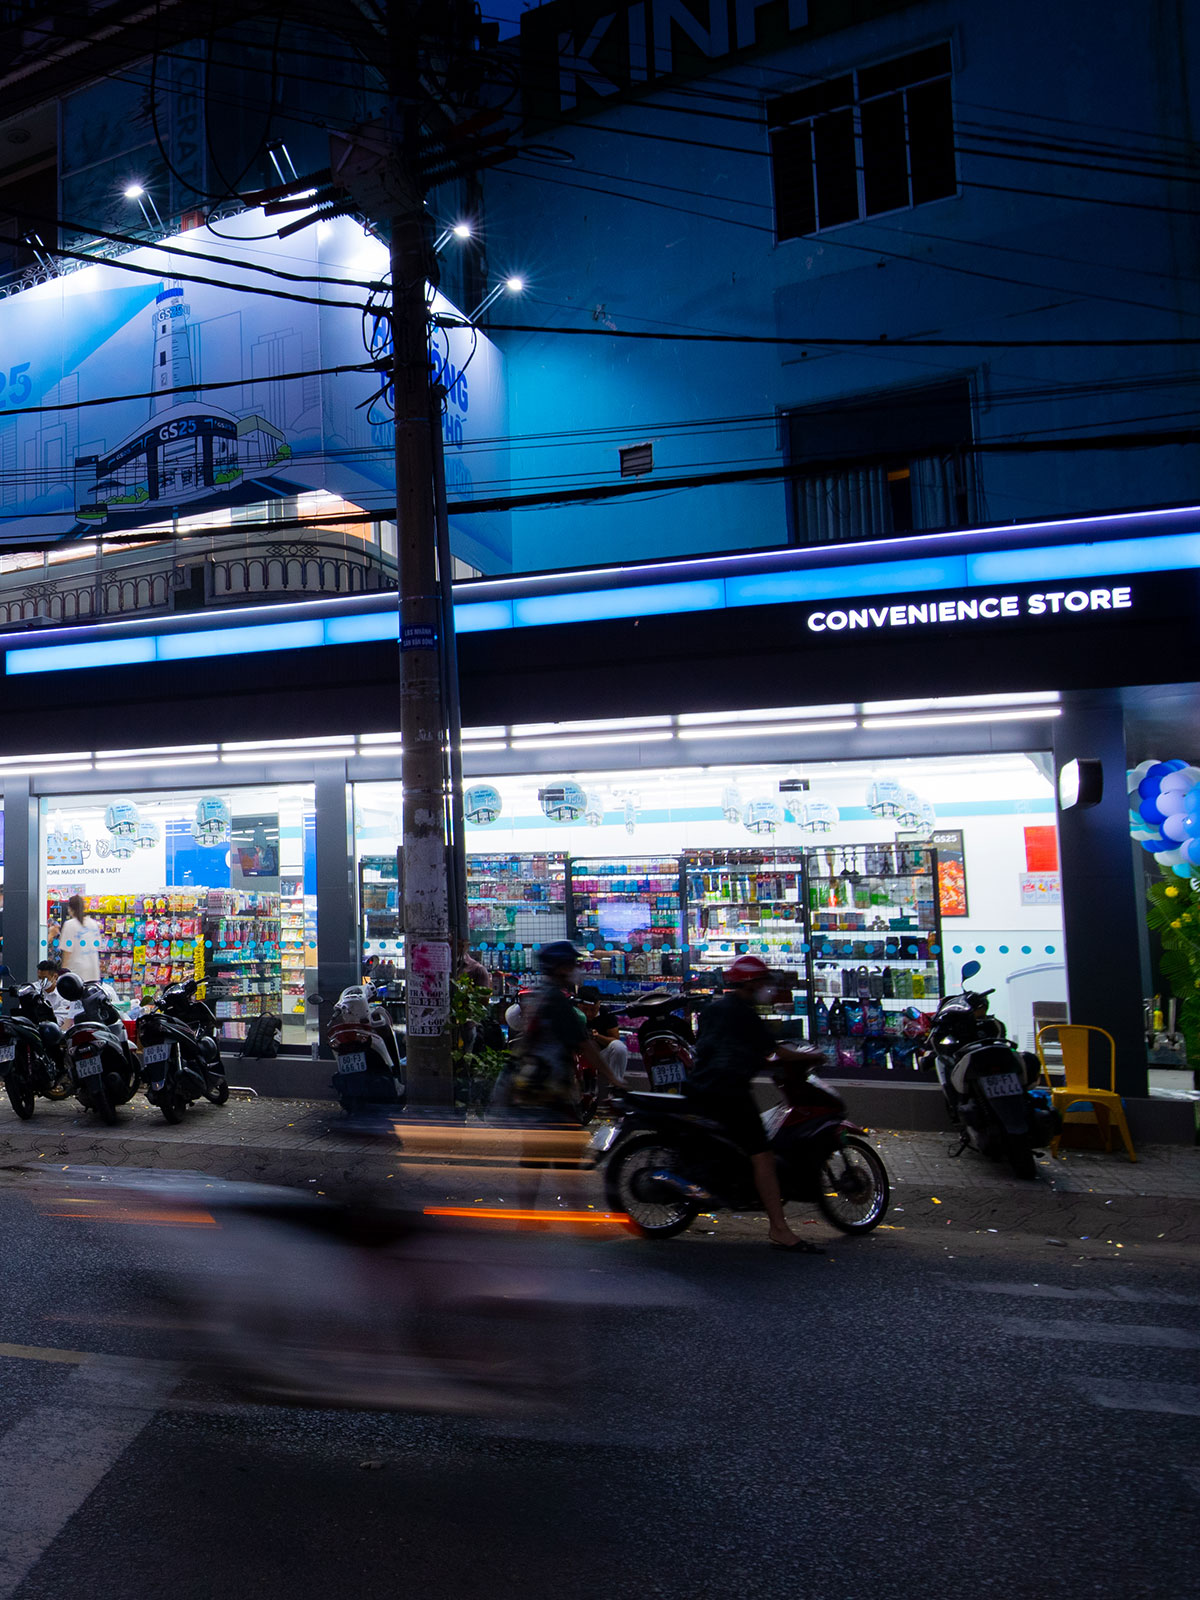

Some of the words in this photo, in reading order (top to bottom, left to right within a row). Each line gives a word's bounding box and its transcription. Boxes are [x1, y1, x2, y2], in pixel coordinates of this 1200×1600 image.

[158, 303, 184, 321] GS25
[159, 419, 198, 441] GS25
[807, 595, 1020, 632] CONVENIENCE
[1027, 586, 1133, 616] STORE
[933, 834, 958, 843] GS25
